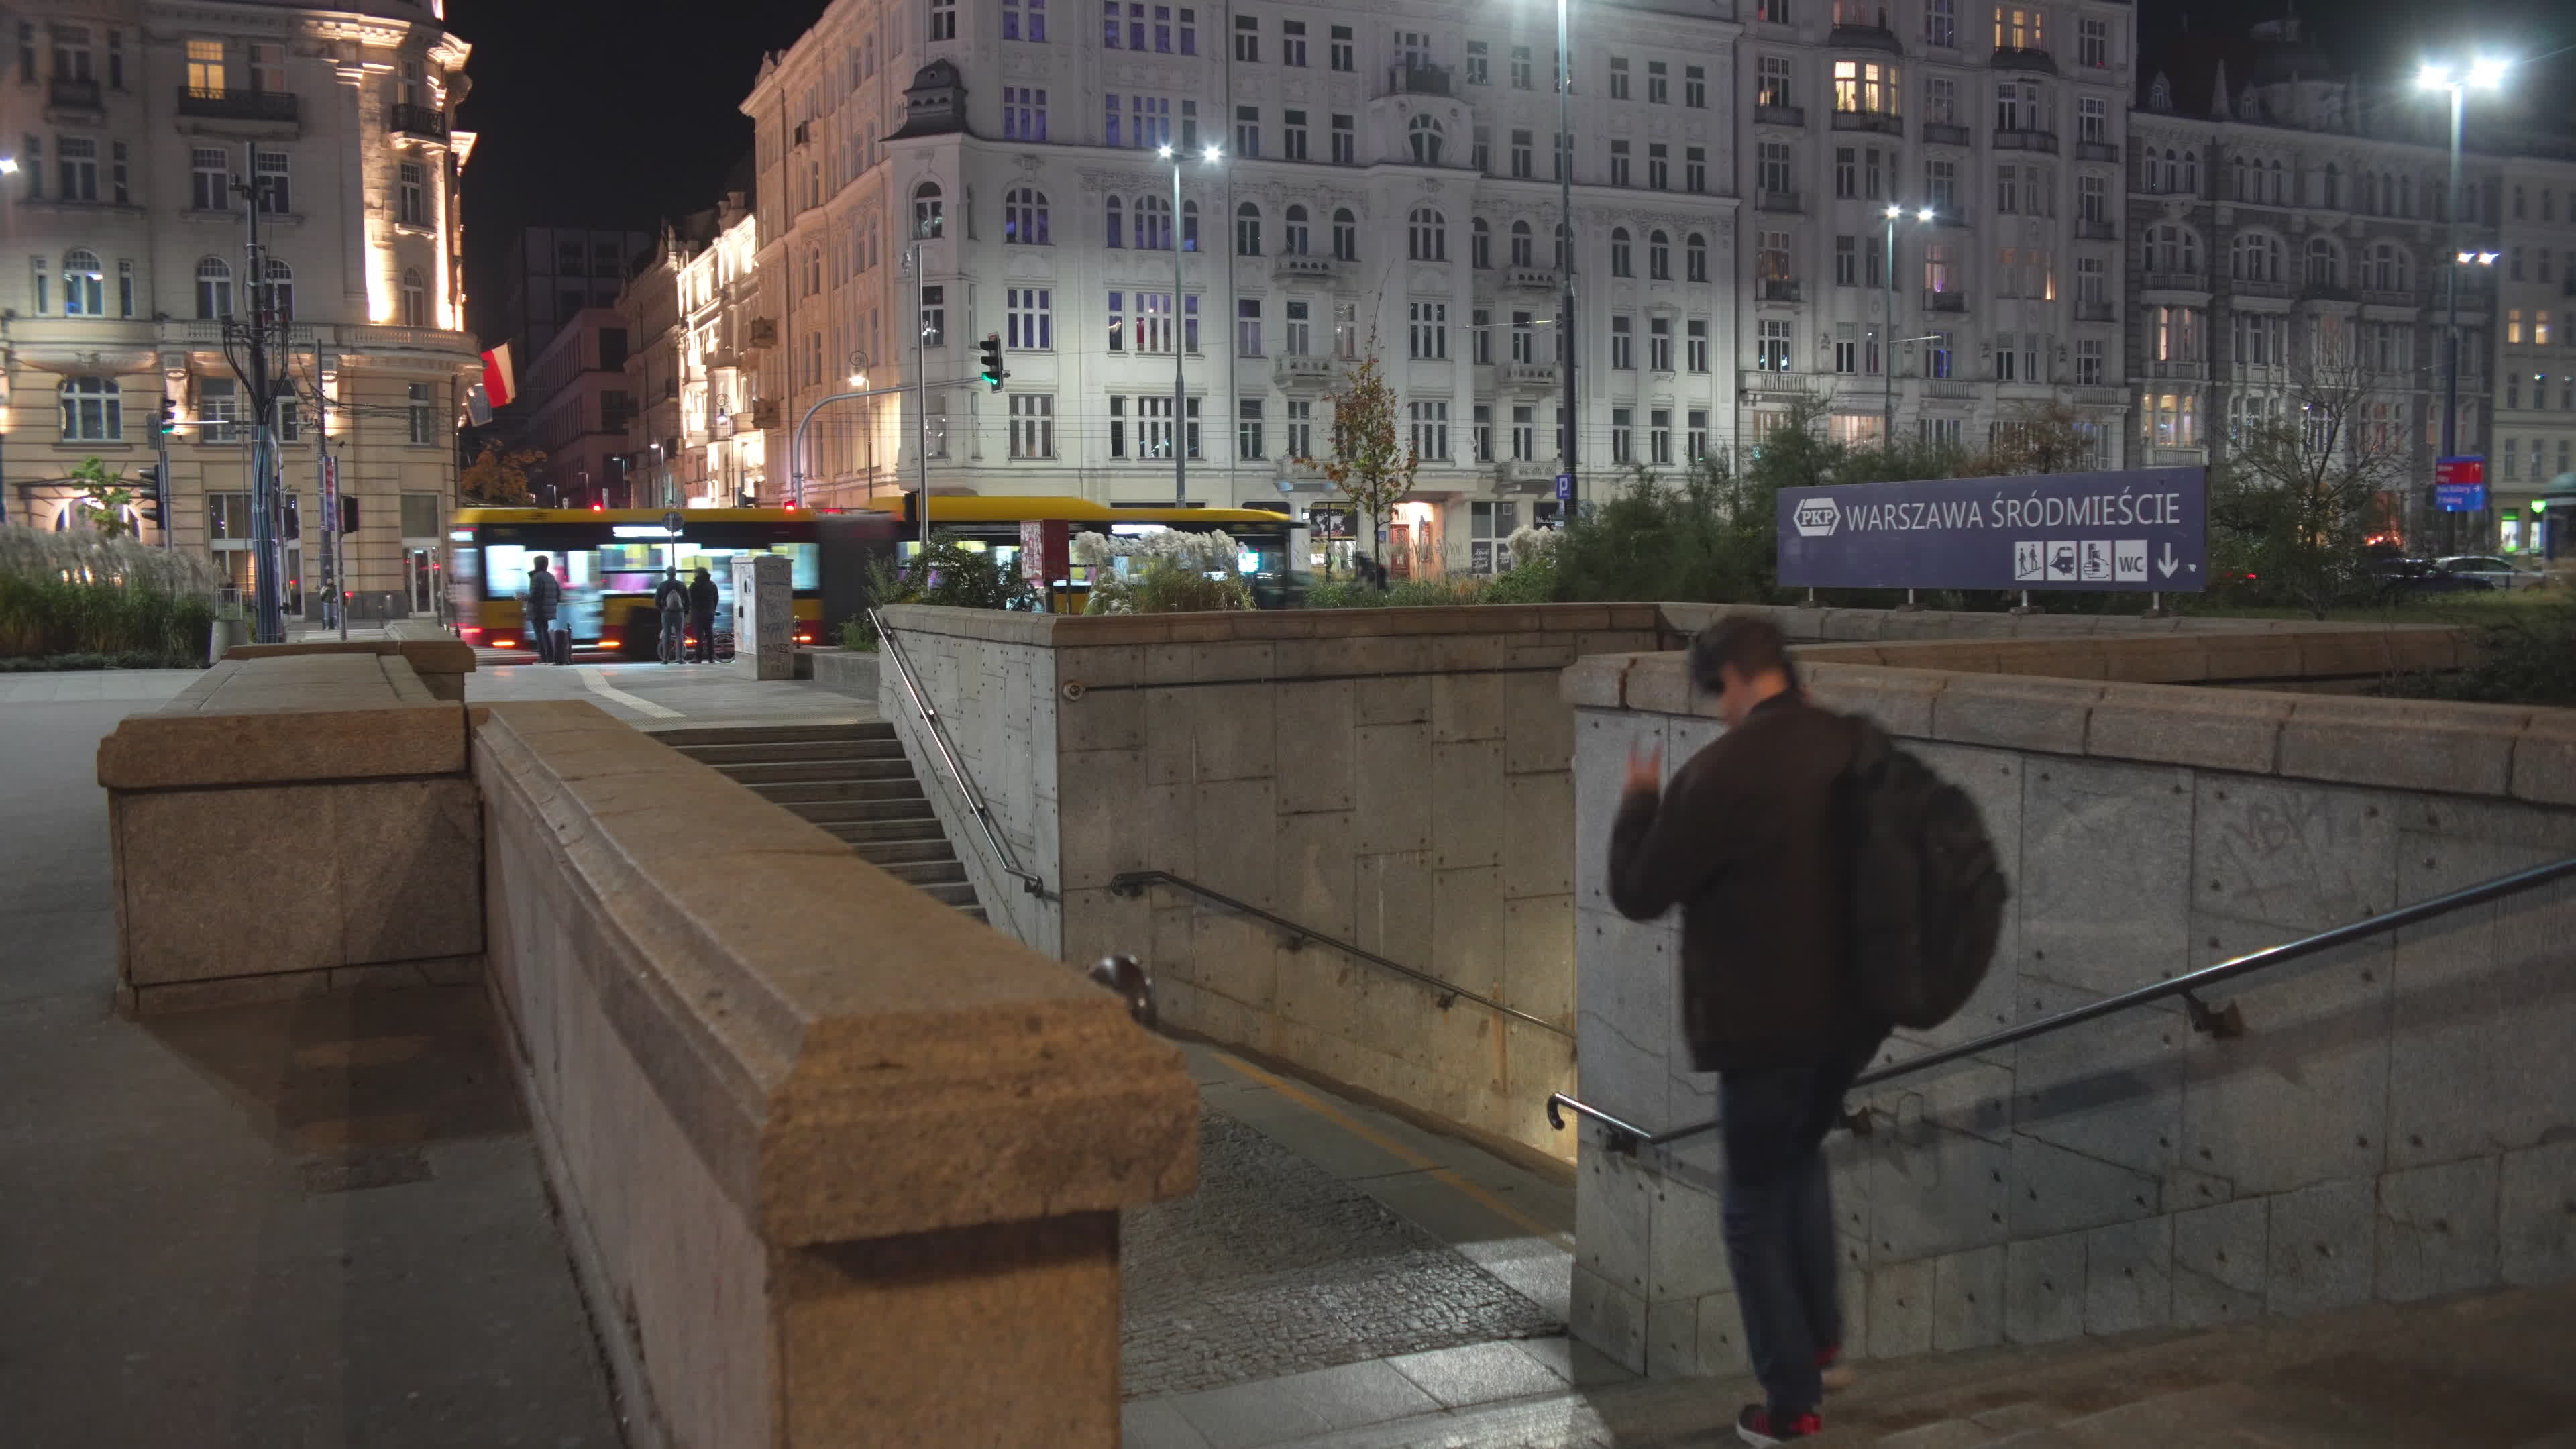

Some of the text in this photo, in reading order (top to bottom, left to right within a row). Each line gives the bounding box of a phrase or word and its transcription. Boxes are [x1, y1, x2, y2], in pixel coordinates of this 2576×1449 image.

[1560, 478, 1568, 496] P
[1801, 509, 1833, 525] PKP
[1845, 486, 2180, 531] WARSZAWA ŚRÓDMIEŚCIE
[2118, 556, 2144, 572] WC
